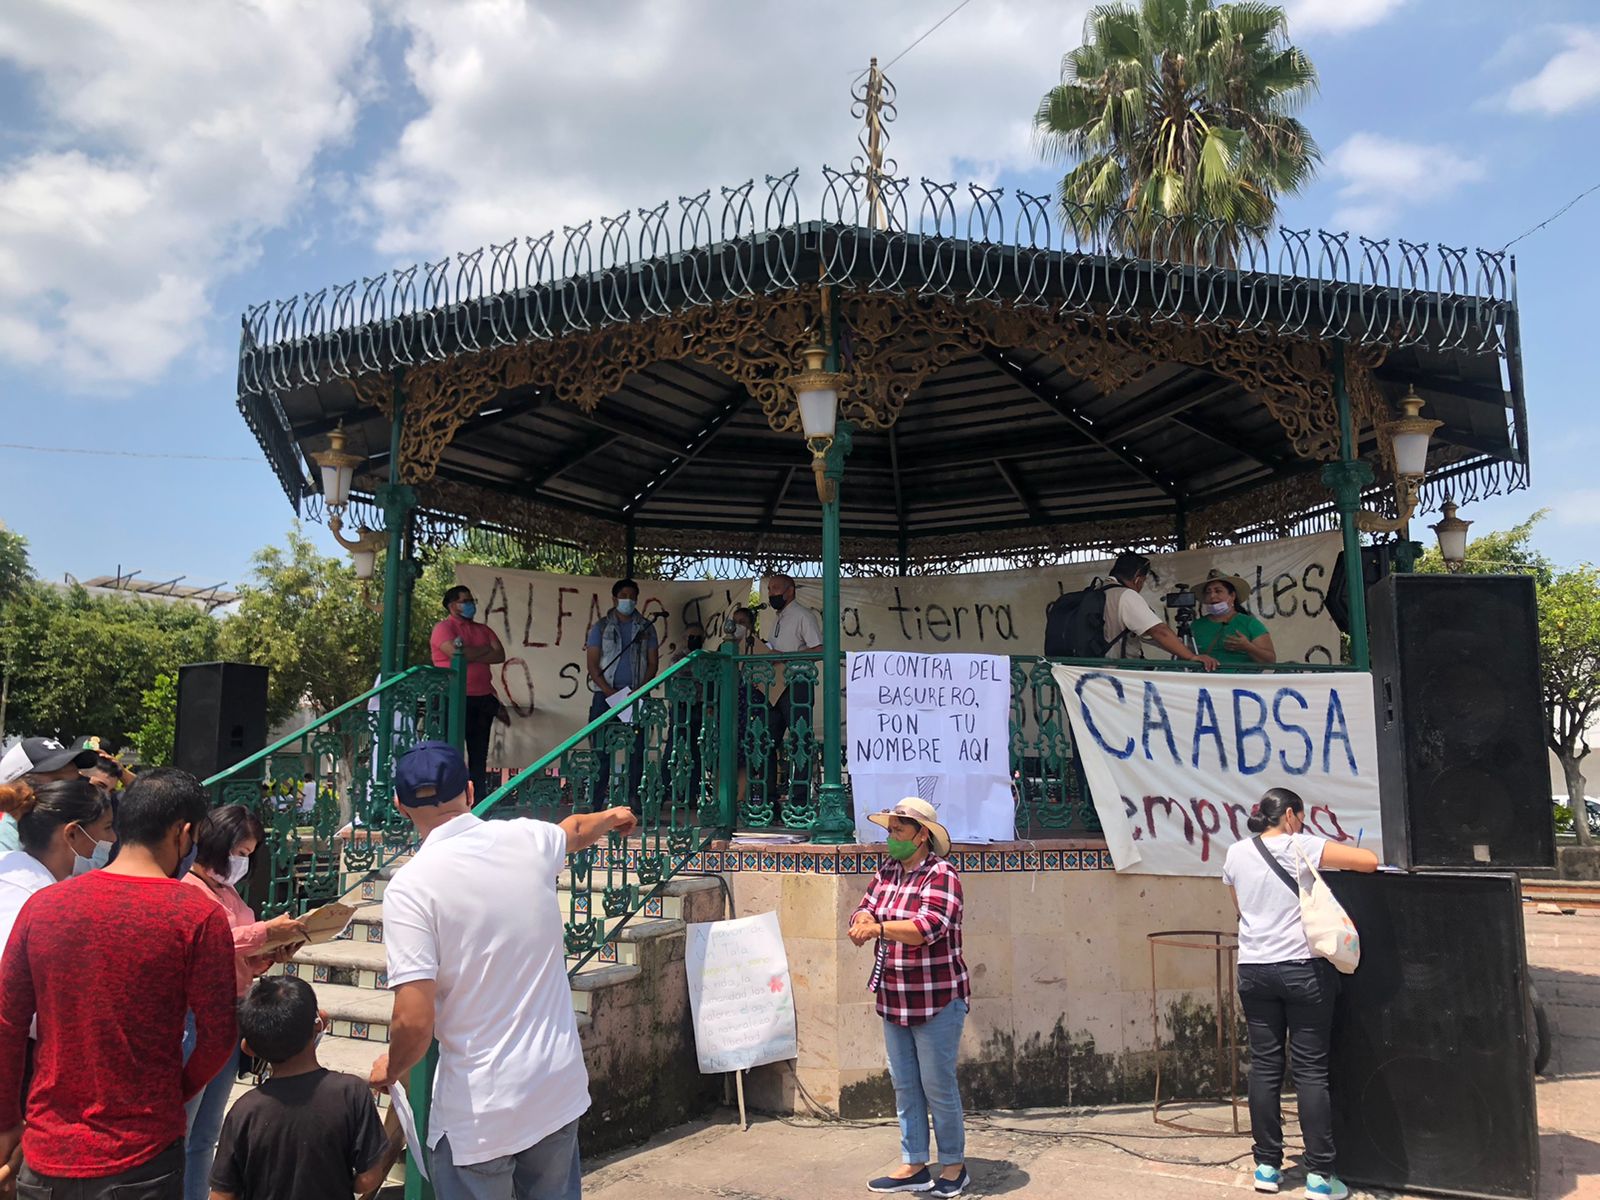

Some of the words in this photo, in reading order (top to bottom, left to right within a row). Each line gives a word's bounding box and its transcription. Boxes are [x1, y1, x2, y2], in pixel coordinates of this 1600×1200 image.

[888, 586, 1019, 642] tierra
[851, 654, 876, 682] EN
[884, 654, 953, 681] CONTRA
[969, 660, 1002, 682] DEL
[878, 685, 980, 708] BASURERO,
[877, 713, 919, 735] PON
[949, 713, 976, 734] TU
[1073, 671, 1359, 776] CAABSA
[856, 737, 942, 763] NOMBRE
[958, 737, 989, 763] AQI
